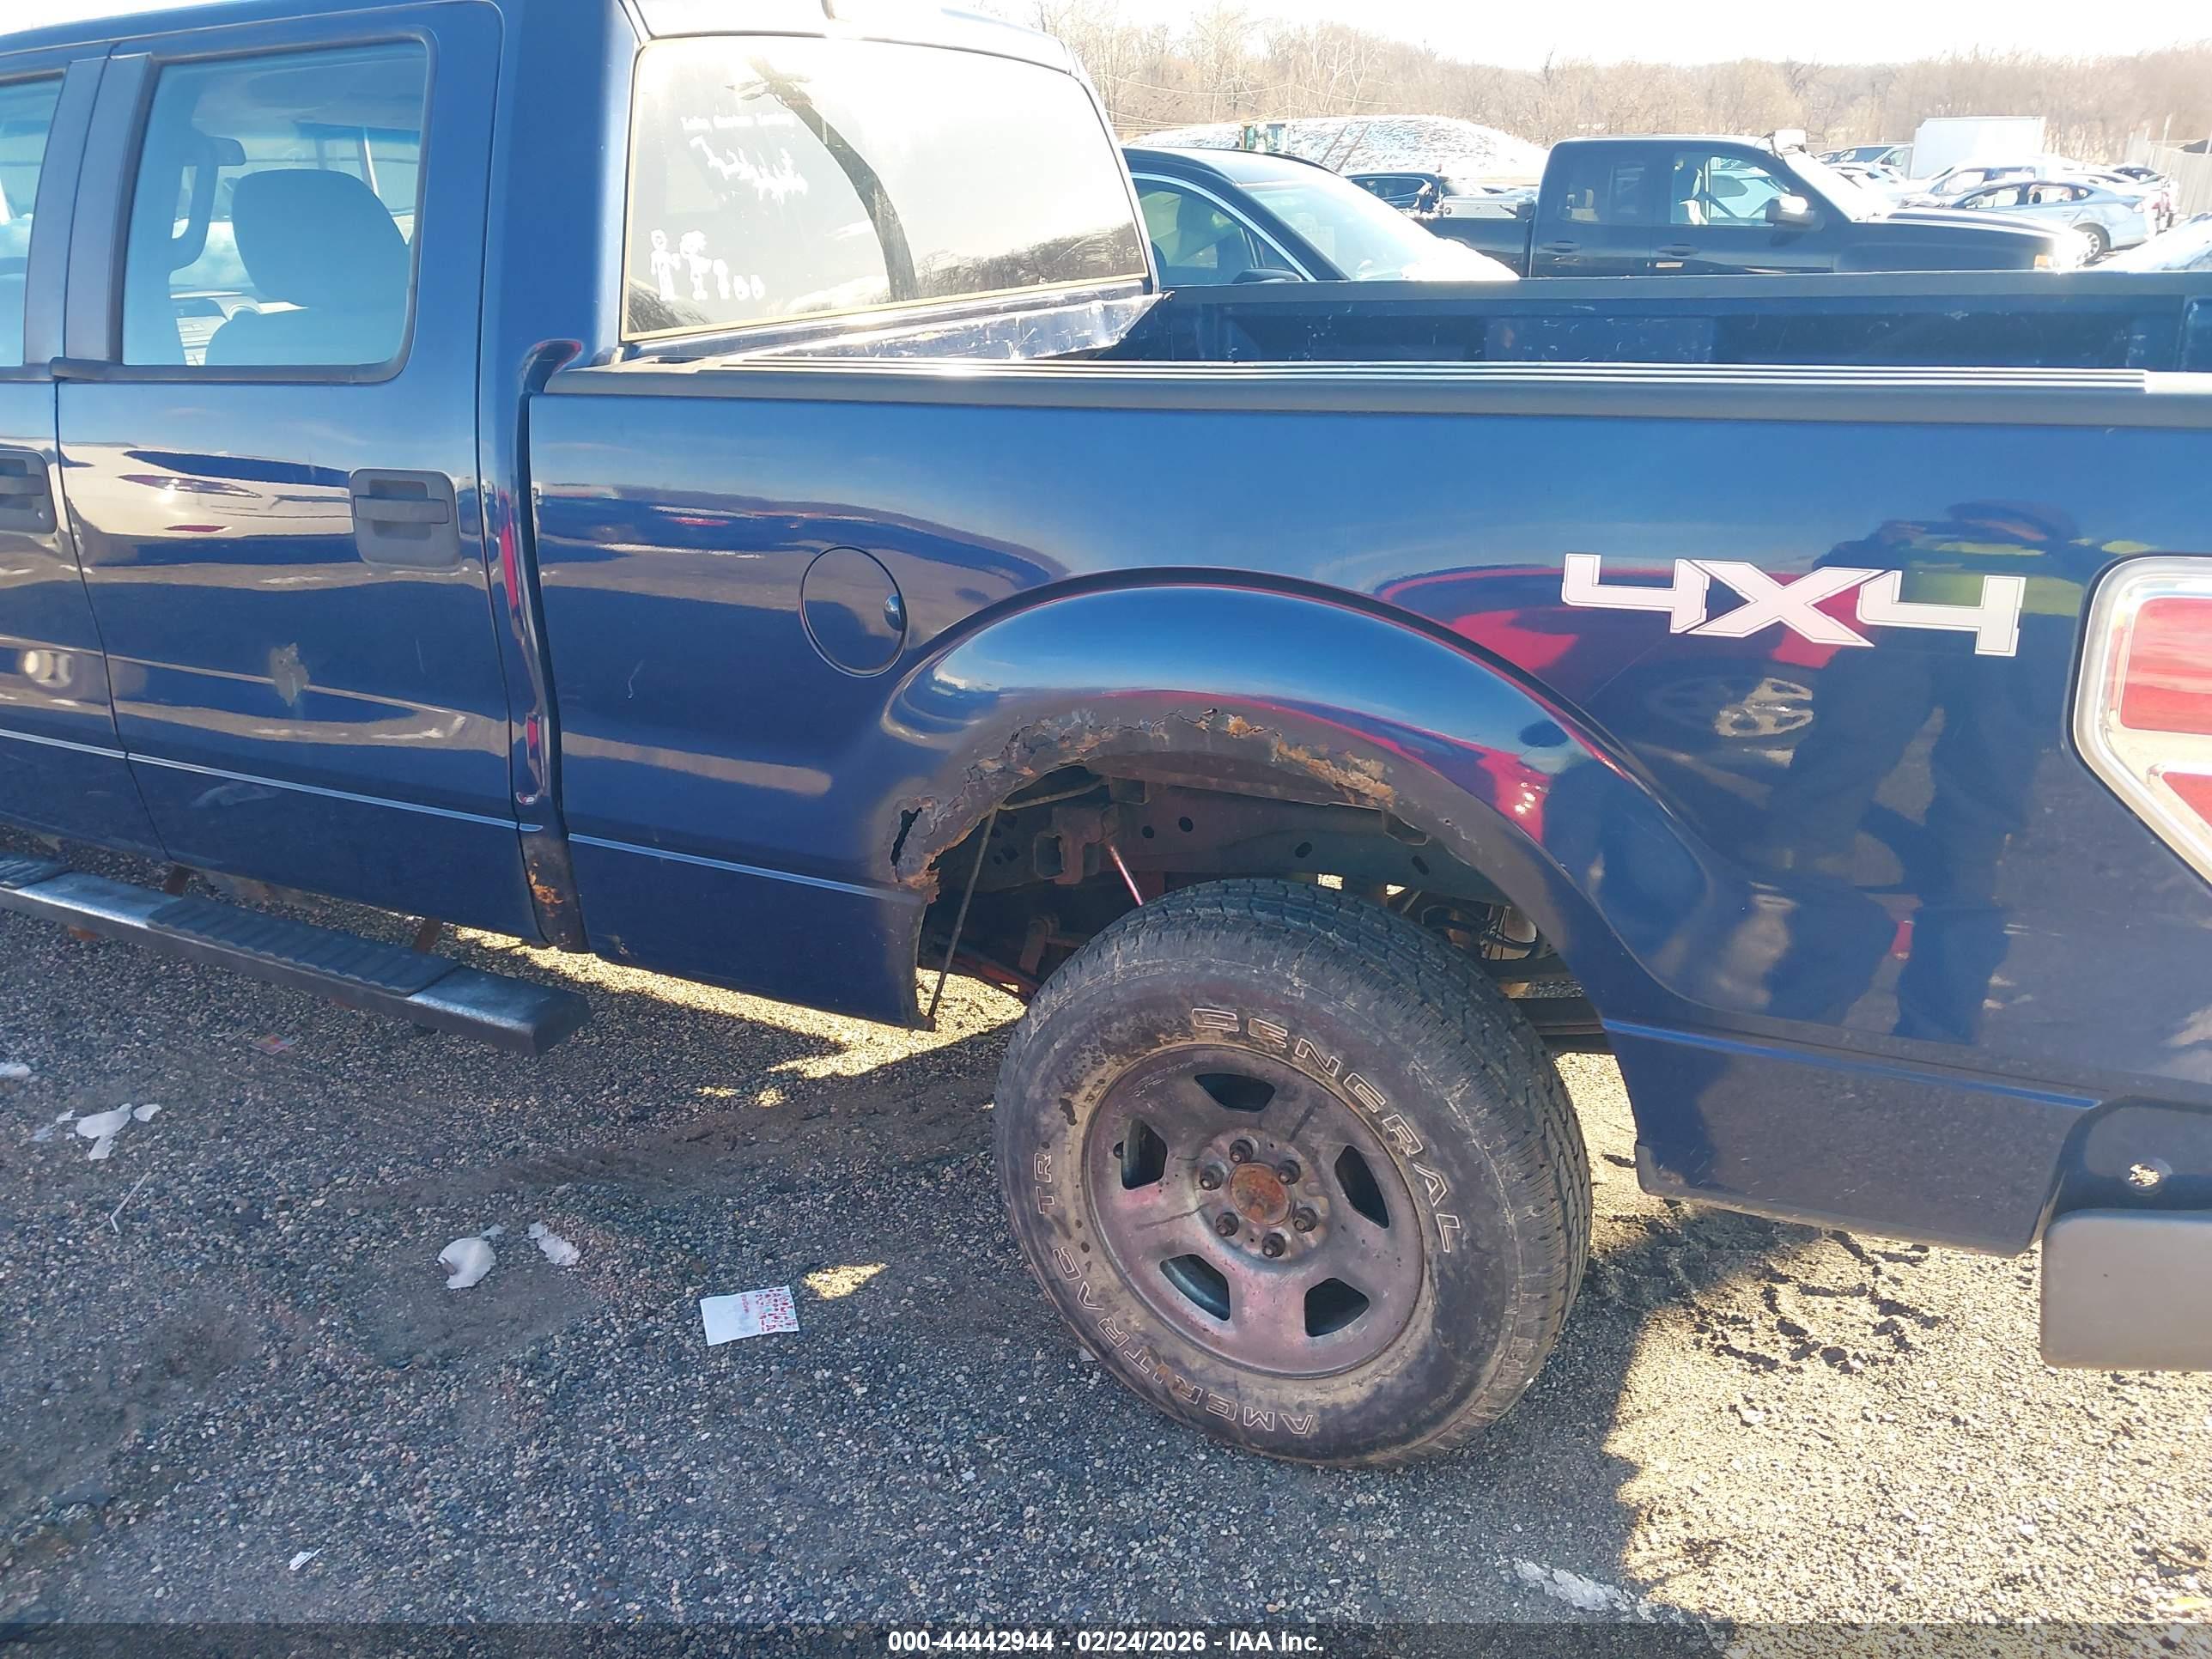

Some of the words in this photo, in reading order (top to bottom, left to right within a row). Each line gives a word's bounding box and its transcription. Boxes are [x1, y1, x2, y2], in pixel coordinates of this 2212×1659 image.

[1560, 553, 2027, 658] 4X4
[1191, 1007, 1461, 1253] GENERAL
[1033, 1152, 1056, 1215] TR
